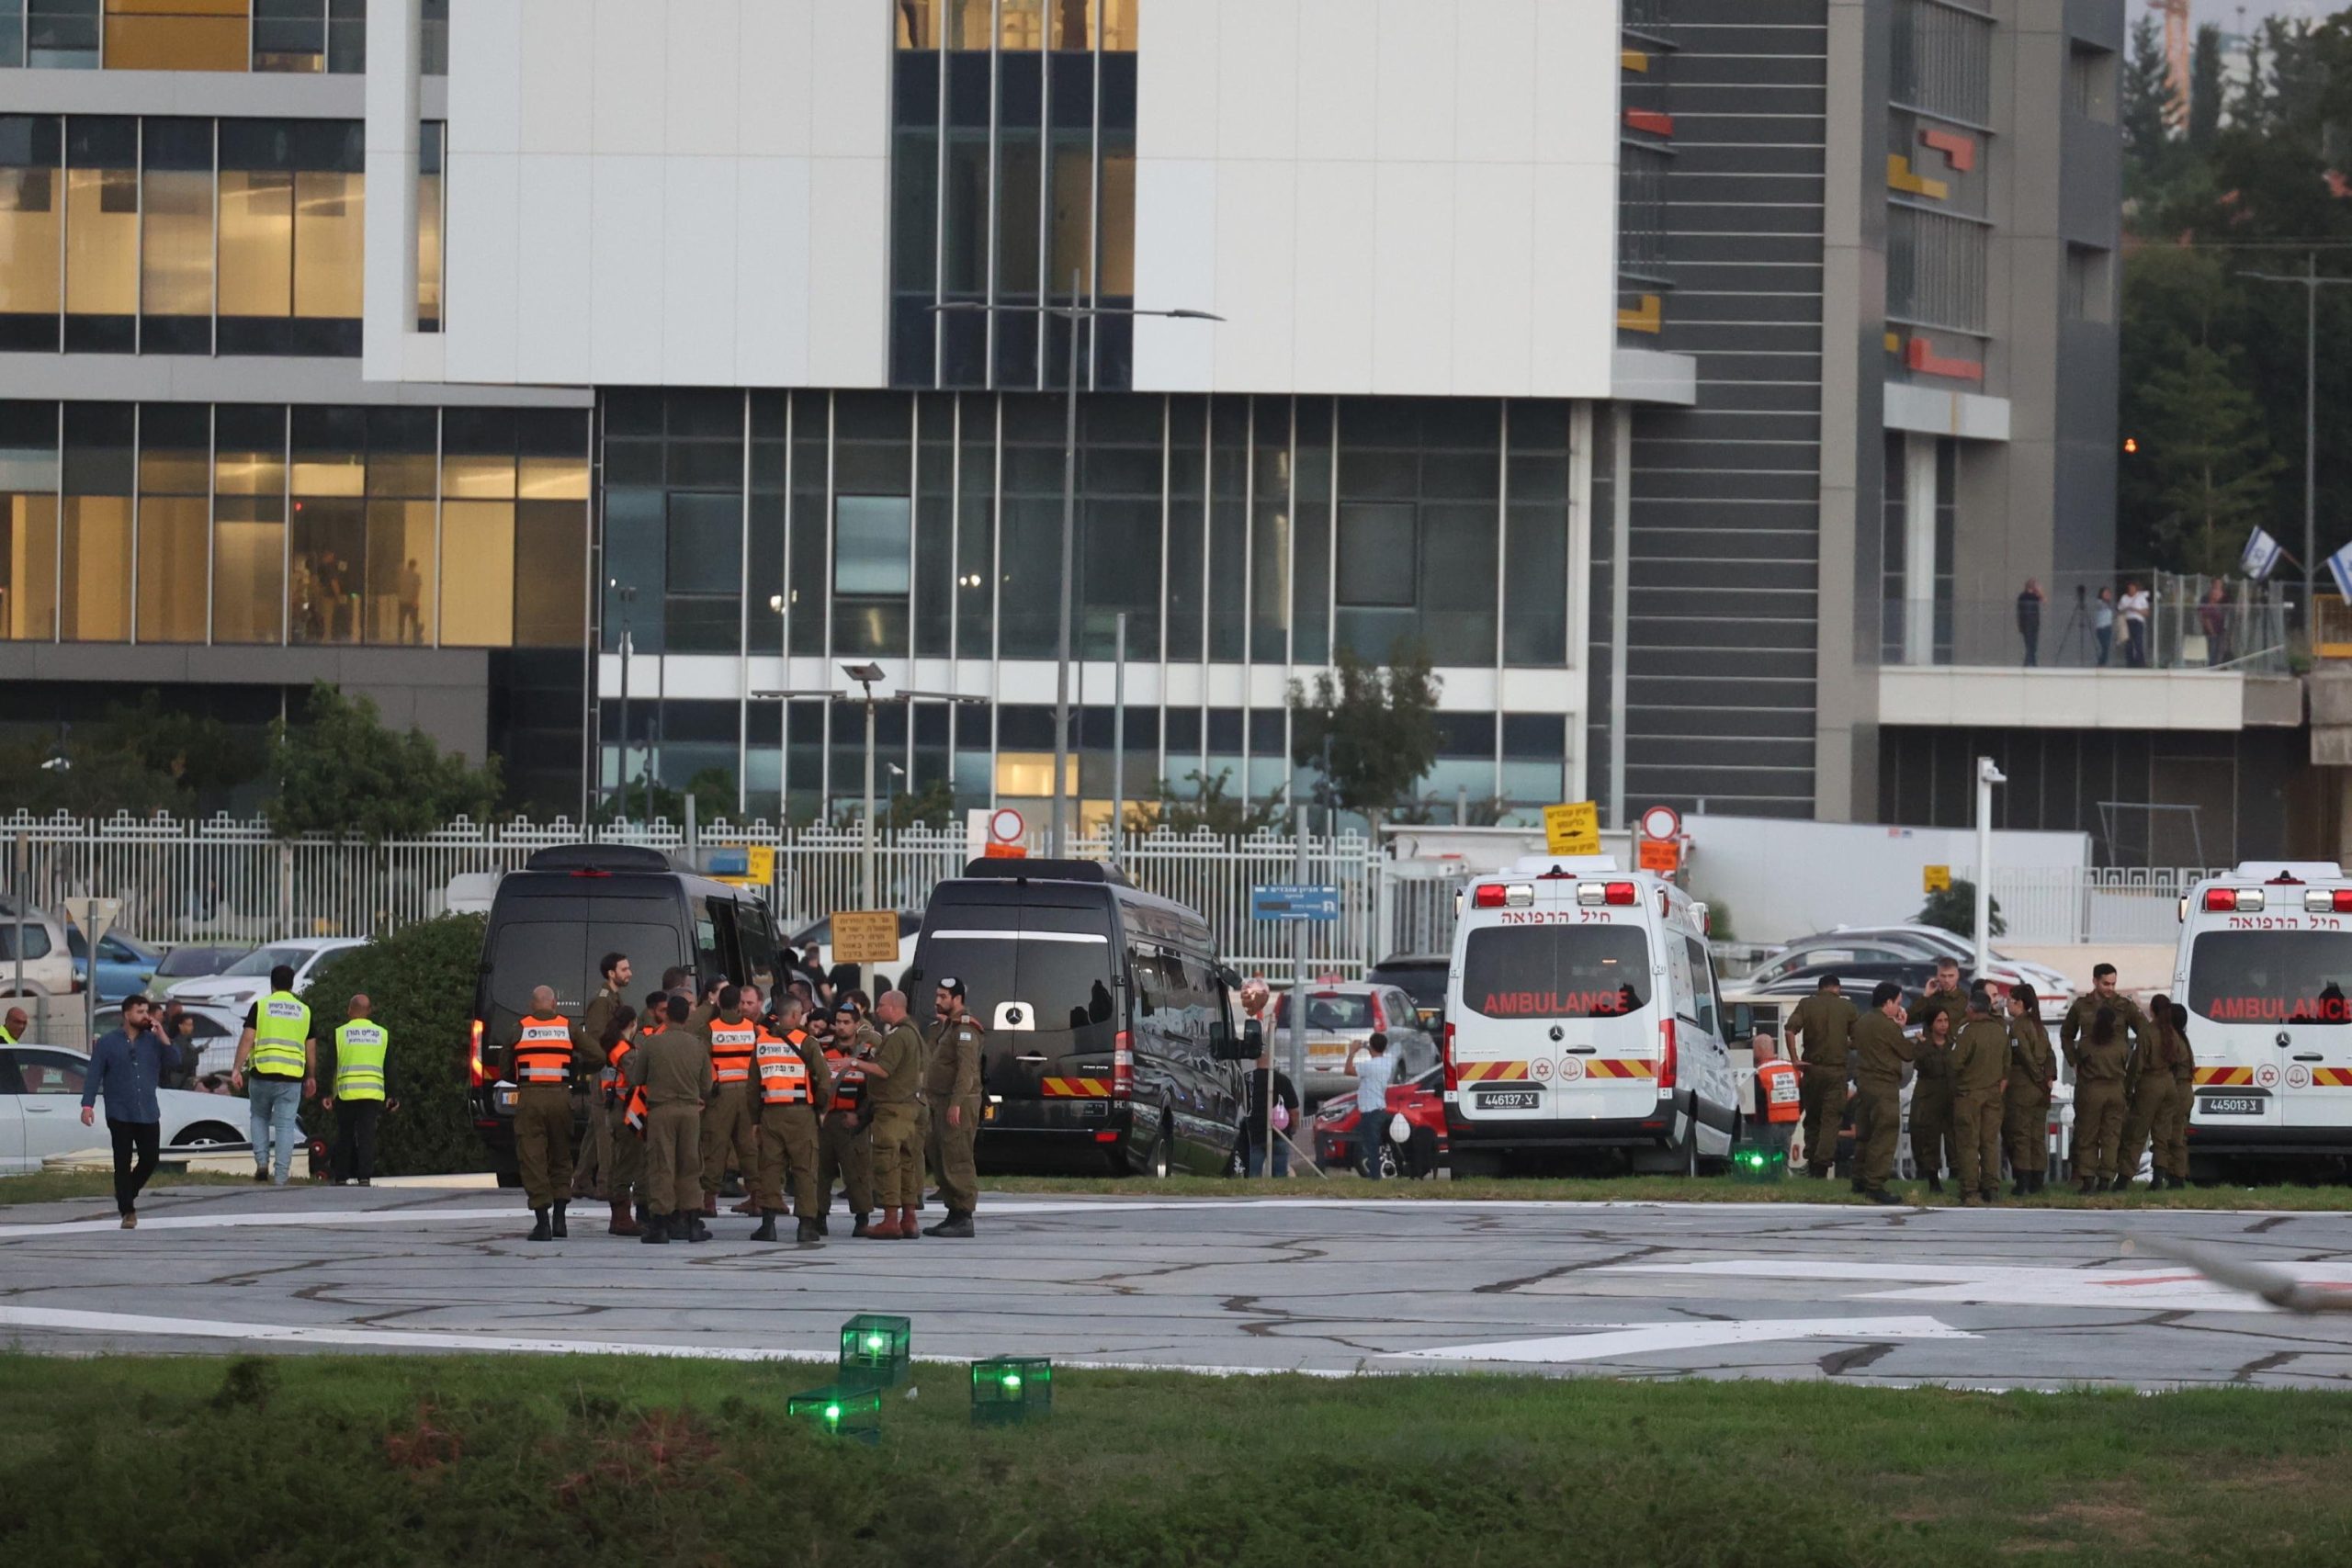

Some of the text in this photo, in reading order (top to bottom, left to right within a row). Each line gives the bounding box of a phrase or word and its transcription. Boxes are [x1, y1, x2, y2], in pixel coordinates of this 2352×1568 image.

[1500, 908, 1611, 924] חיל הרפואה
[2228, 915, 2340, 930] חיל הרפואה
[1484, 991, 1629, 1014] AMBULANCE
[345, 1029, 360, 1037] תורן
[1485, 1094, 1521, 1105] 446137
[2211, 1099, 2247, 1111] 445013
